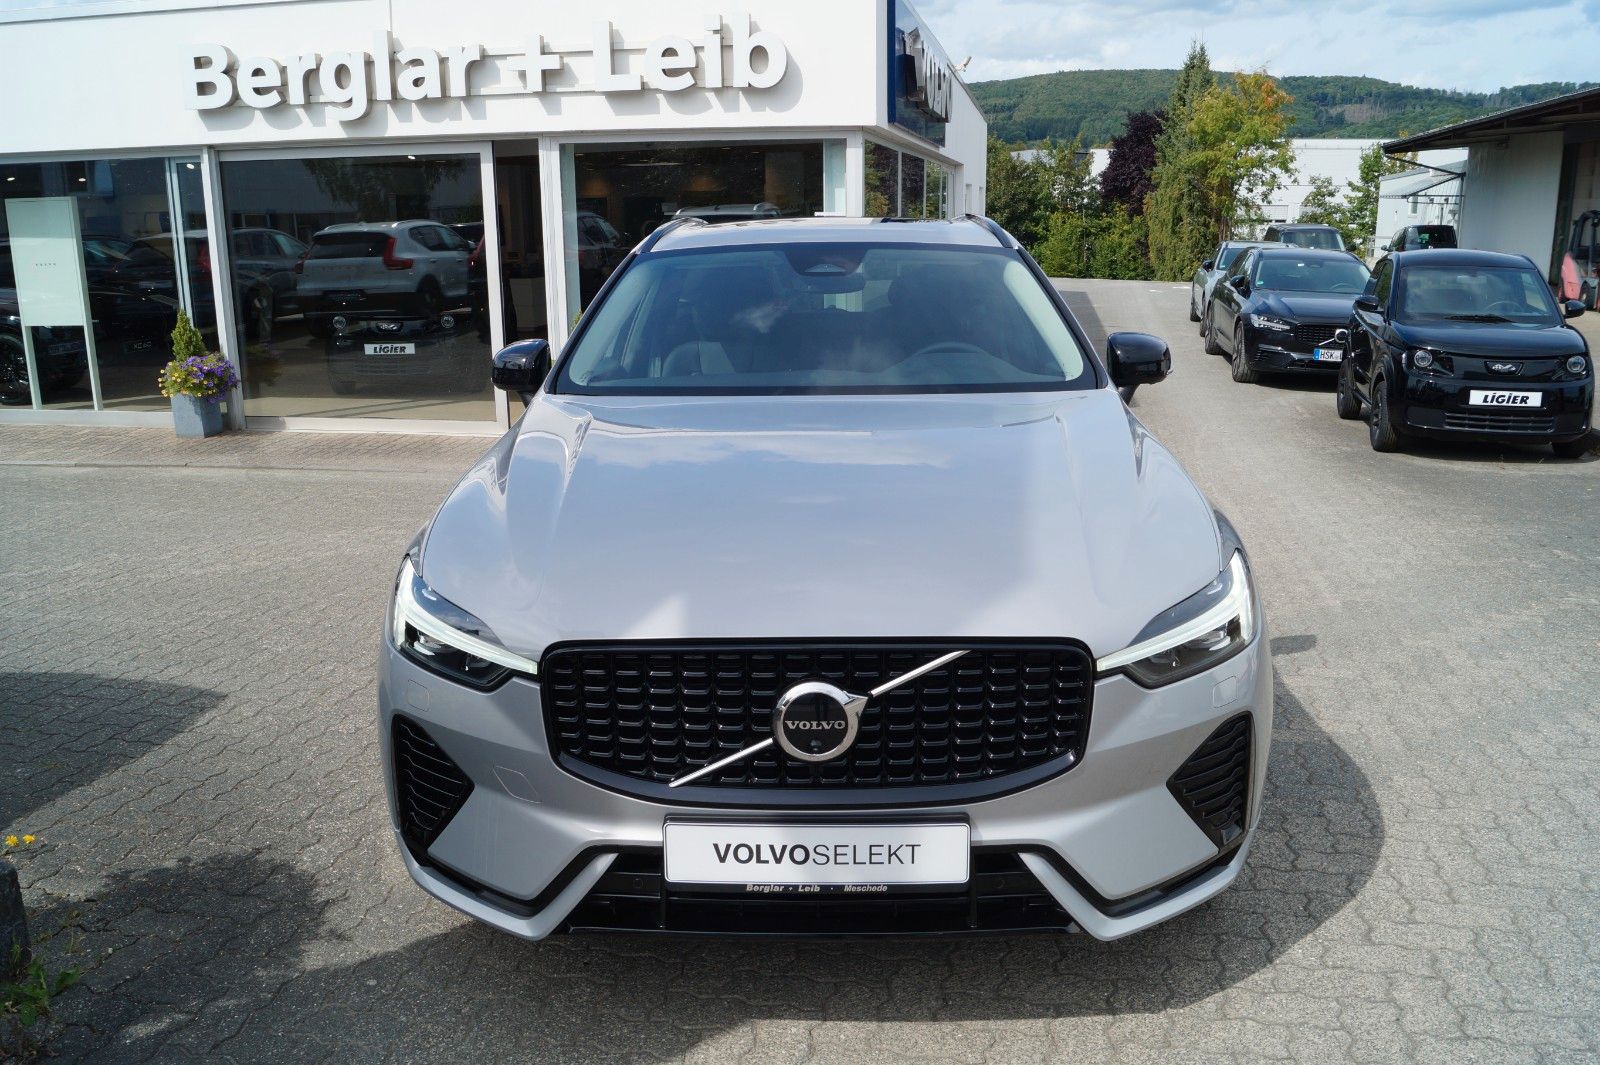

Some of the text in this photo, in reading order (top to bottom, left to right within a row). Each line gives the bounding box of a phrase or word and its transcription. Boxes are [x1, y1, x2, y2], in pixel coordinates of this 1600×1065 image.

[188, 13, 789, 123] Berglar + Leib
[1320, 351, 1335, 360] HSK
[785, 720, 846, 730] VOLVO
[712, 843, 921, 865] VOLVOSELEKT
[746, 884, 784, 893] Berglar
[798, 884, 821, 893] Leib
[843, 884, 888, 893] Meschede
